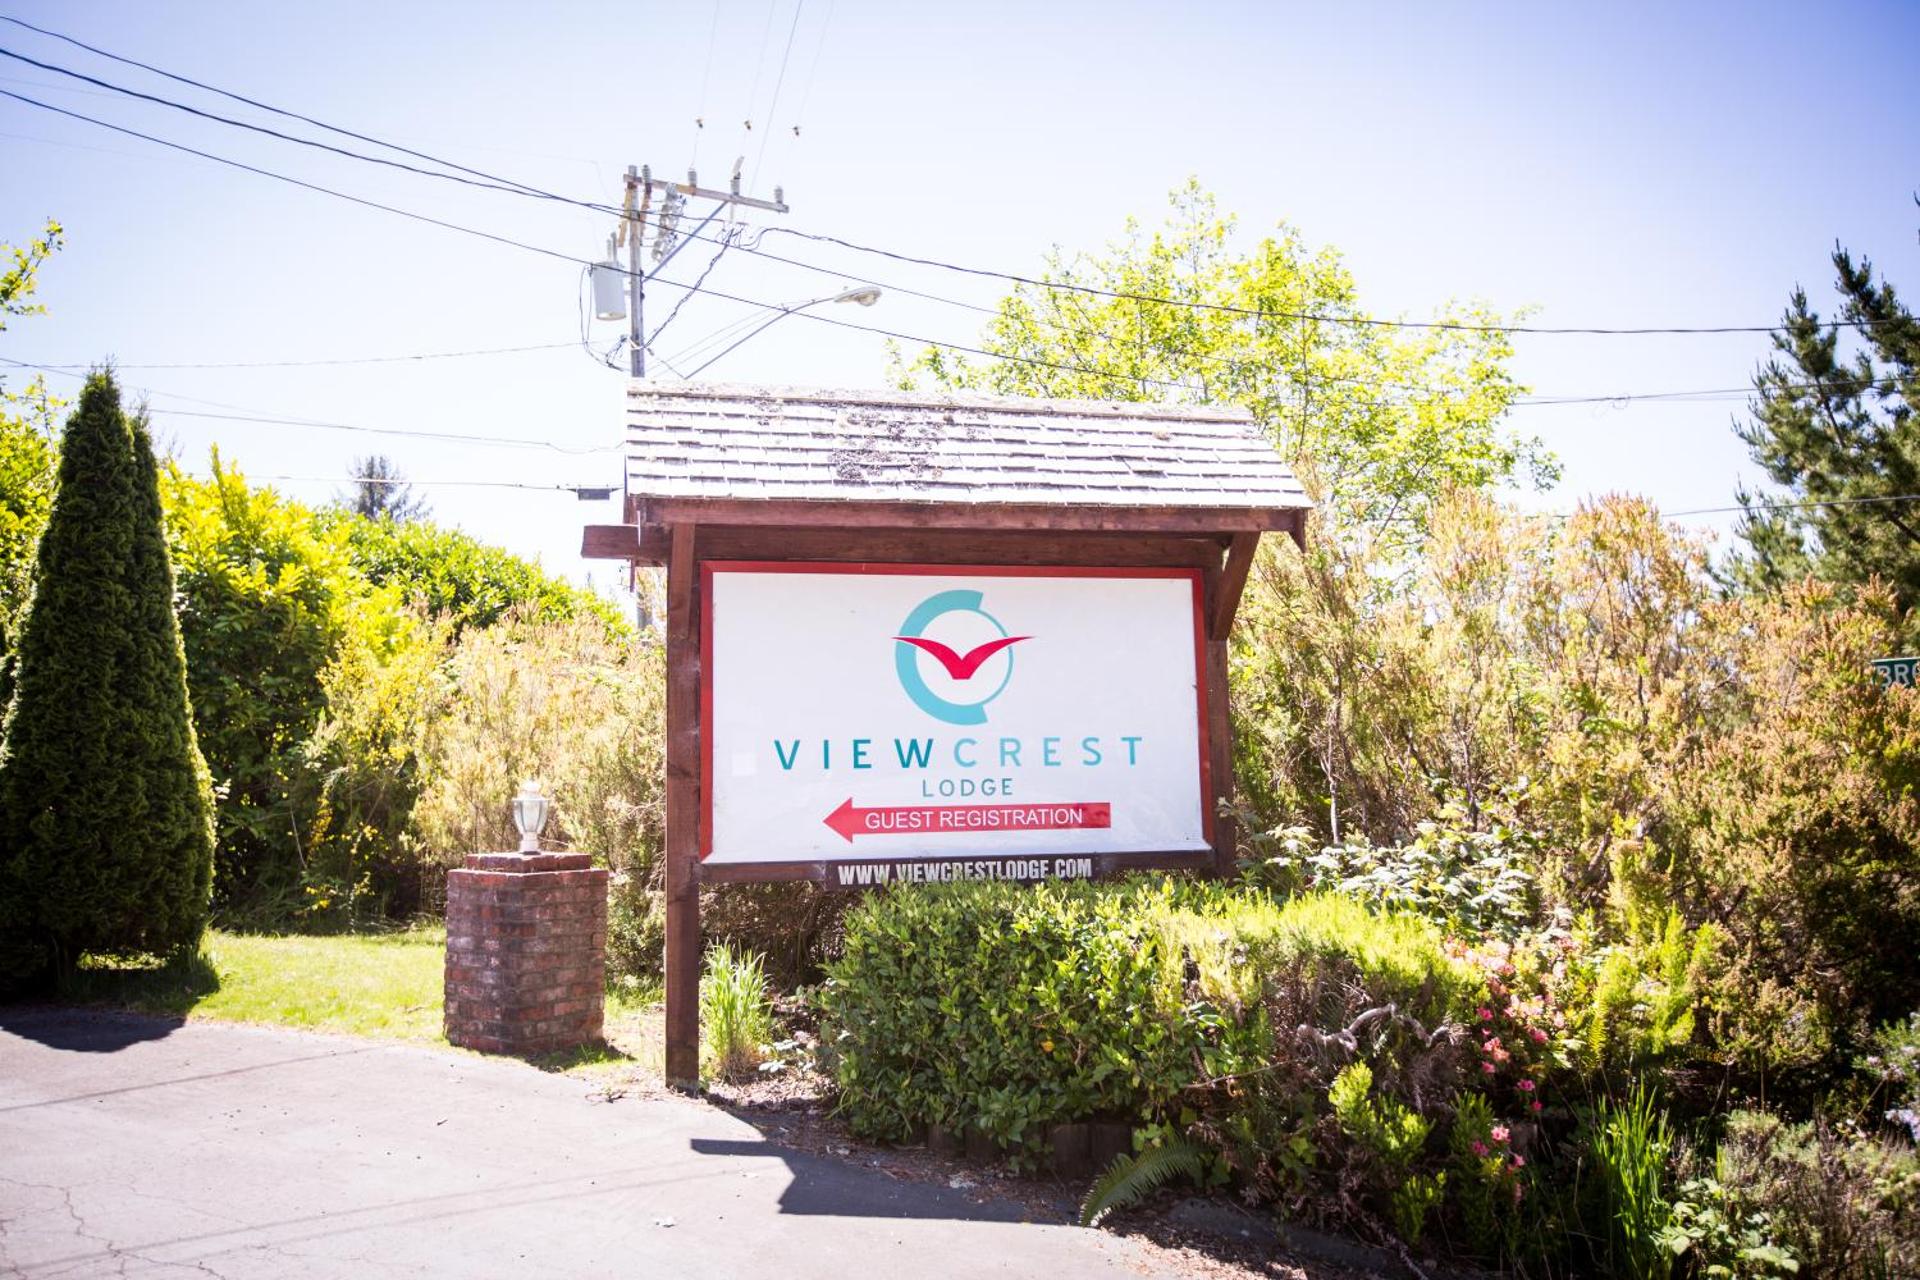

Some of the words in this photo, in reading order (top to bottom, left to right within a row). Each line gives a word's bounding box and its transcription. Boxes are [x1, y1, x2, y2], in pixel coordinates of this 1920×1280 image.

[774, 737, 1143, 770] VIEWCREST
[922, 778, 1013, 798] LODGE
[865, 811, 934, 830] GUEST
[940, 808, 1083, 828] REGISTRATION
[838, 858, 1092, 885] WWW.VIEWCRESTLODGECOM
